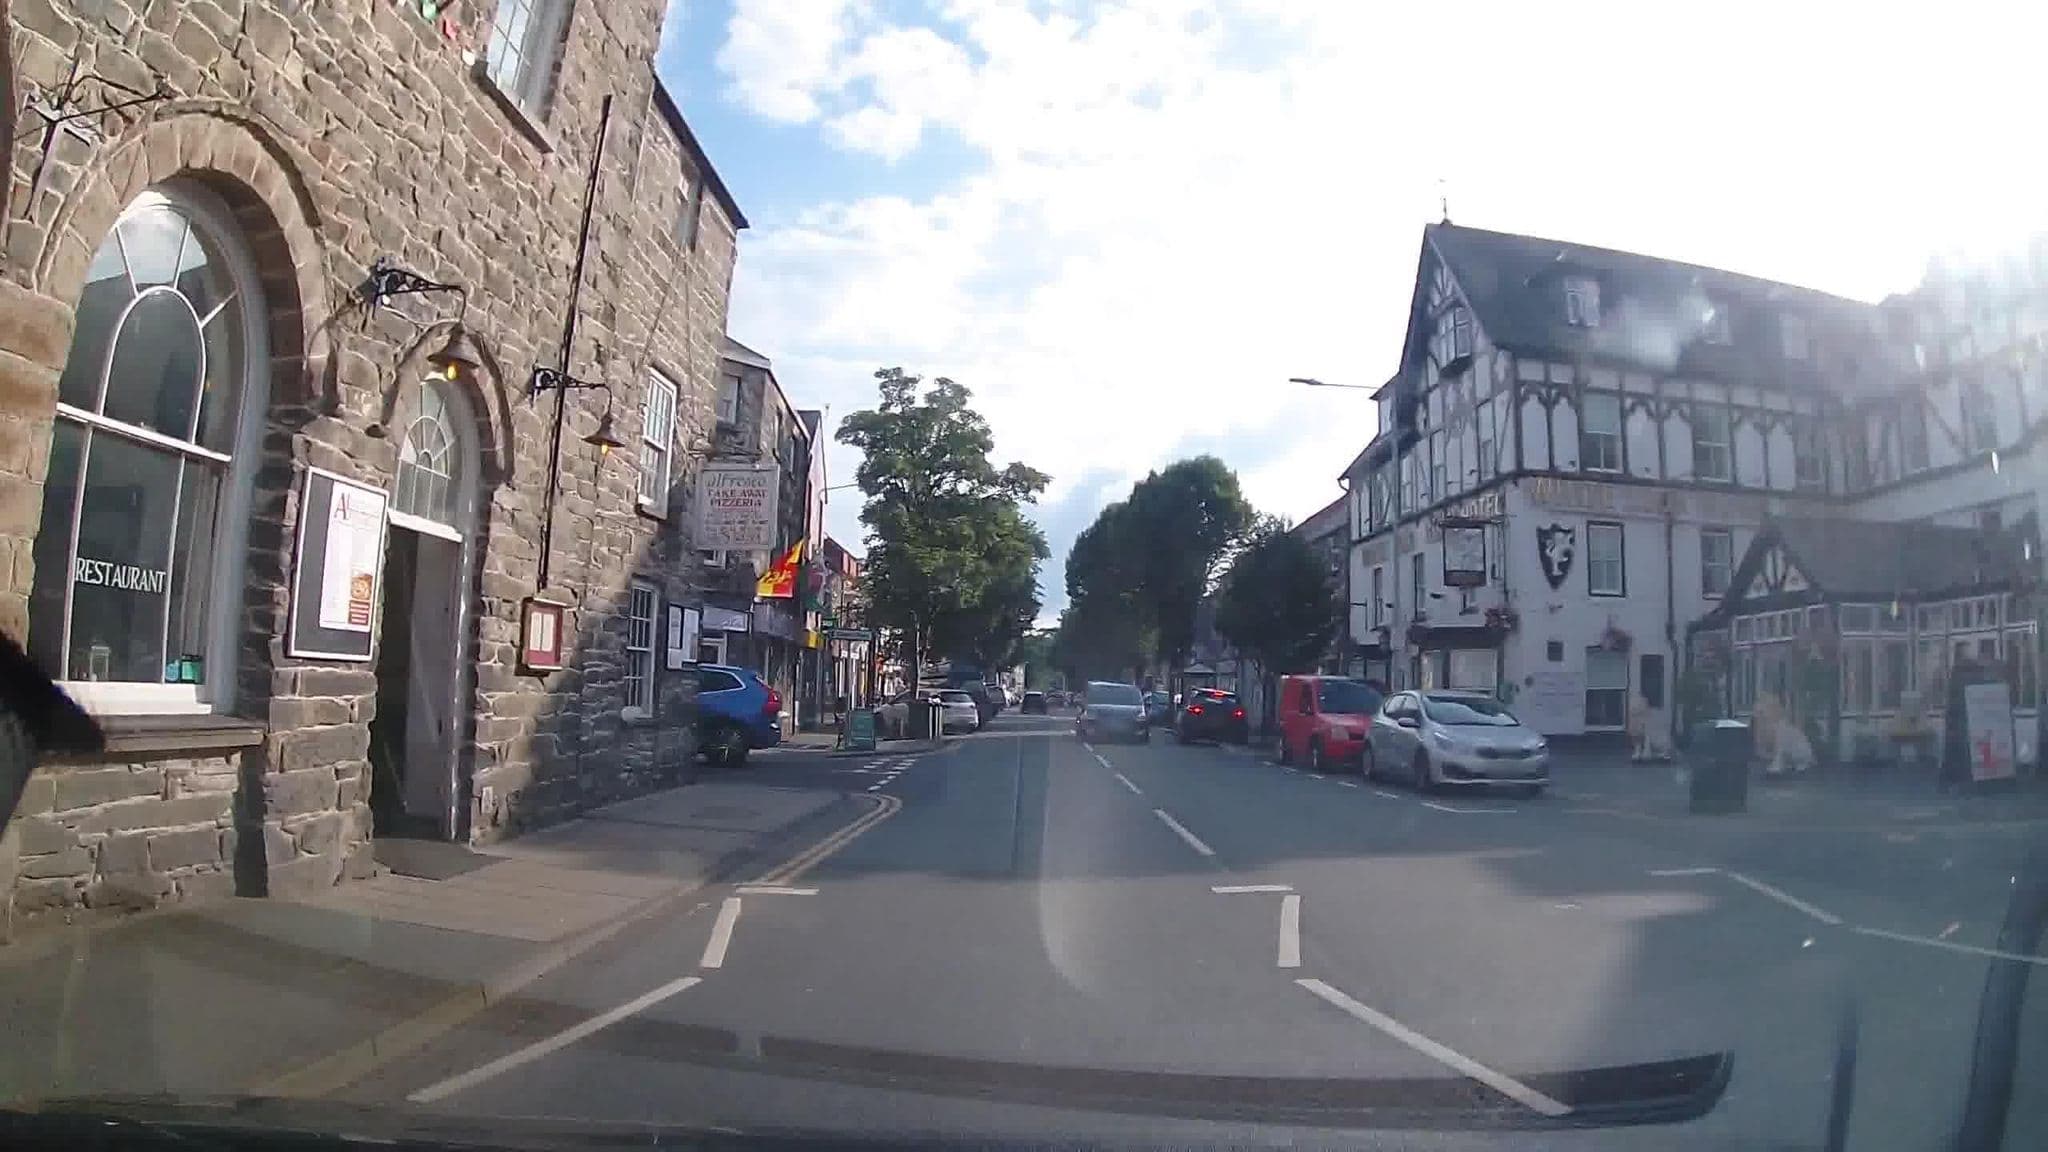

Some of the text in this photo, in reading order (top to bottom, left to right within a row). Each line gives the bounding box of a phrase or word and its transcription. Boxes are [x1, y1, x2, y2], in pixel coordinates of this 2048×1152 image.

[707, 488, 768, 498] TAKE AWAY
[710, 498, 763, 508] PIZZERIA
[75, 557, 167, 593] RESTAURANT
